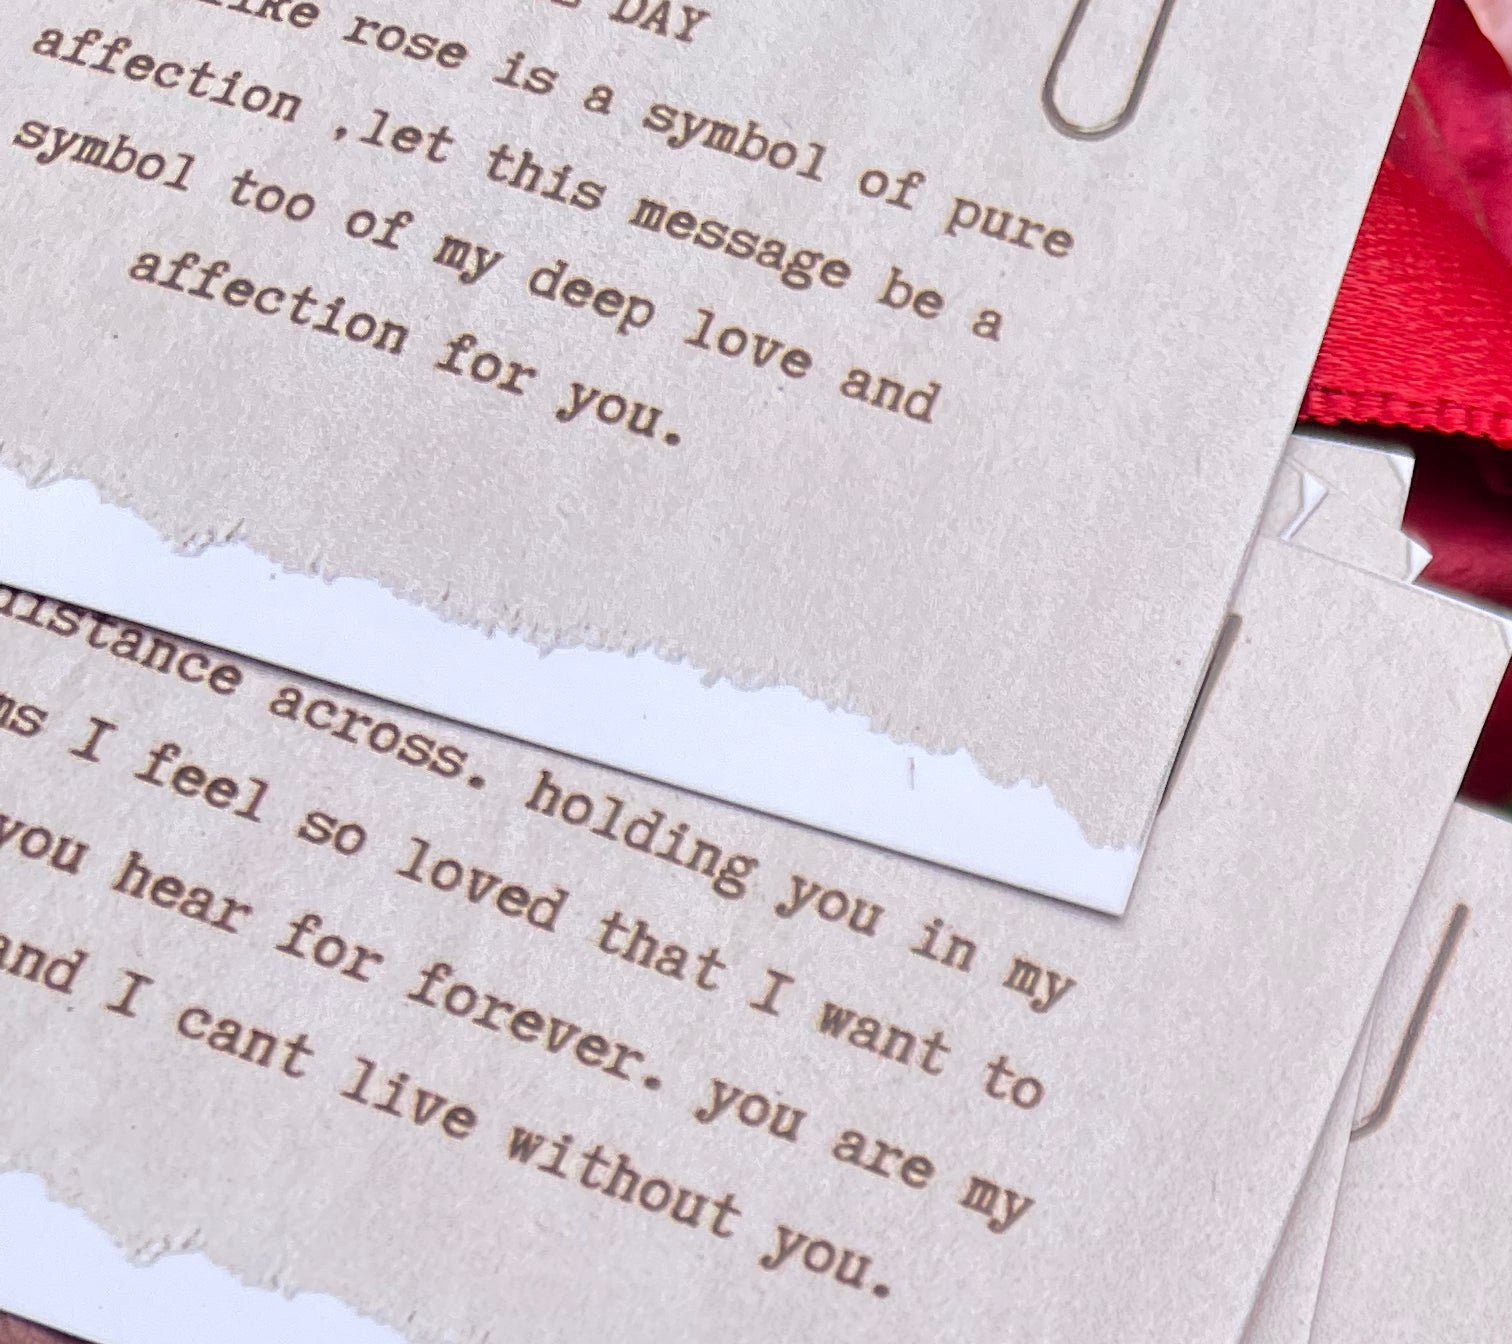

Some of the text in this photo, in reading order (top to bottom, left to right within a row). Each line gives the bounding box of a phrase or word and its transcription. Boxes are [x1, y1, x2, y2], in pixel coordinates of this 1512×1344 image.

[12, 119, 943, 424] symbol too of my deep love and
[32, 27, 303, 123] affection
[486, 143, 608, 211] this
[628, 197, 852, 291] message
[876, 265, 945, 320] be
[971, 309, 1003, 342] a
[342, 15, 469, 69] rose
[491, 50, 560, 96] is
[583, 84, 615, 116] a
[641, 102, 827, 182] symbol
[859, 169, 927, 211] of
[943, 197, 1075, 259] pure
[128, 251, 681, 447] affection for you.
[68, 716, 119, 763] I
[133, 742, 269, 824] feel
[296, 810, 368, 856] so
[395, 836, 570, 933] loved
[598, 910, 727, 991] that
[749, 968, 795, 1017] I
[819, 1001, 952, 1076] want
[985, 1055, 1045, 1110] to
[269, 681, 486, 790] across.
[524, 770, 759, 901] holding
[774, 874, 885, 937] you
[910, 917, 977, 973] in
[1002, 957, 1077, 1014] my
[105, 969, 155, 1018] I
[177, 1006, 315, 1079] cant
[339, 1056, 478, 1140] live
[508, 1126, 742, 1239] without
[758, 1224, 890, 1299] you.
[111, 850, 254, 934] hear
[274, 913, 385, 983] for
[406, 961, 662, 1091] forever.
[693, 1077, 807, 1143] you
[831, 1129, 935, 1189] are
[959, 1175, 1036, 1234] my
